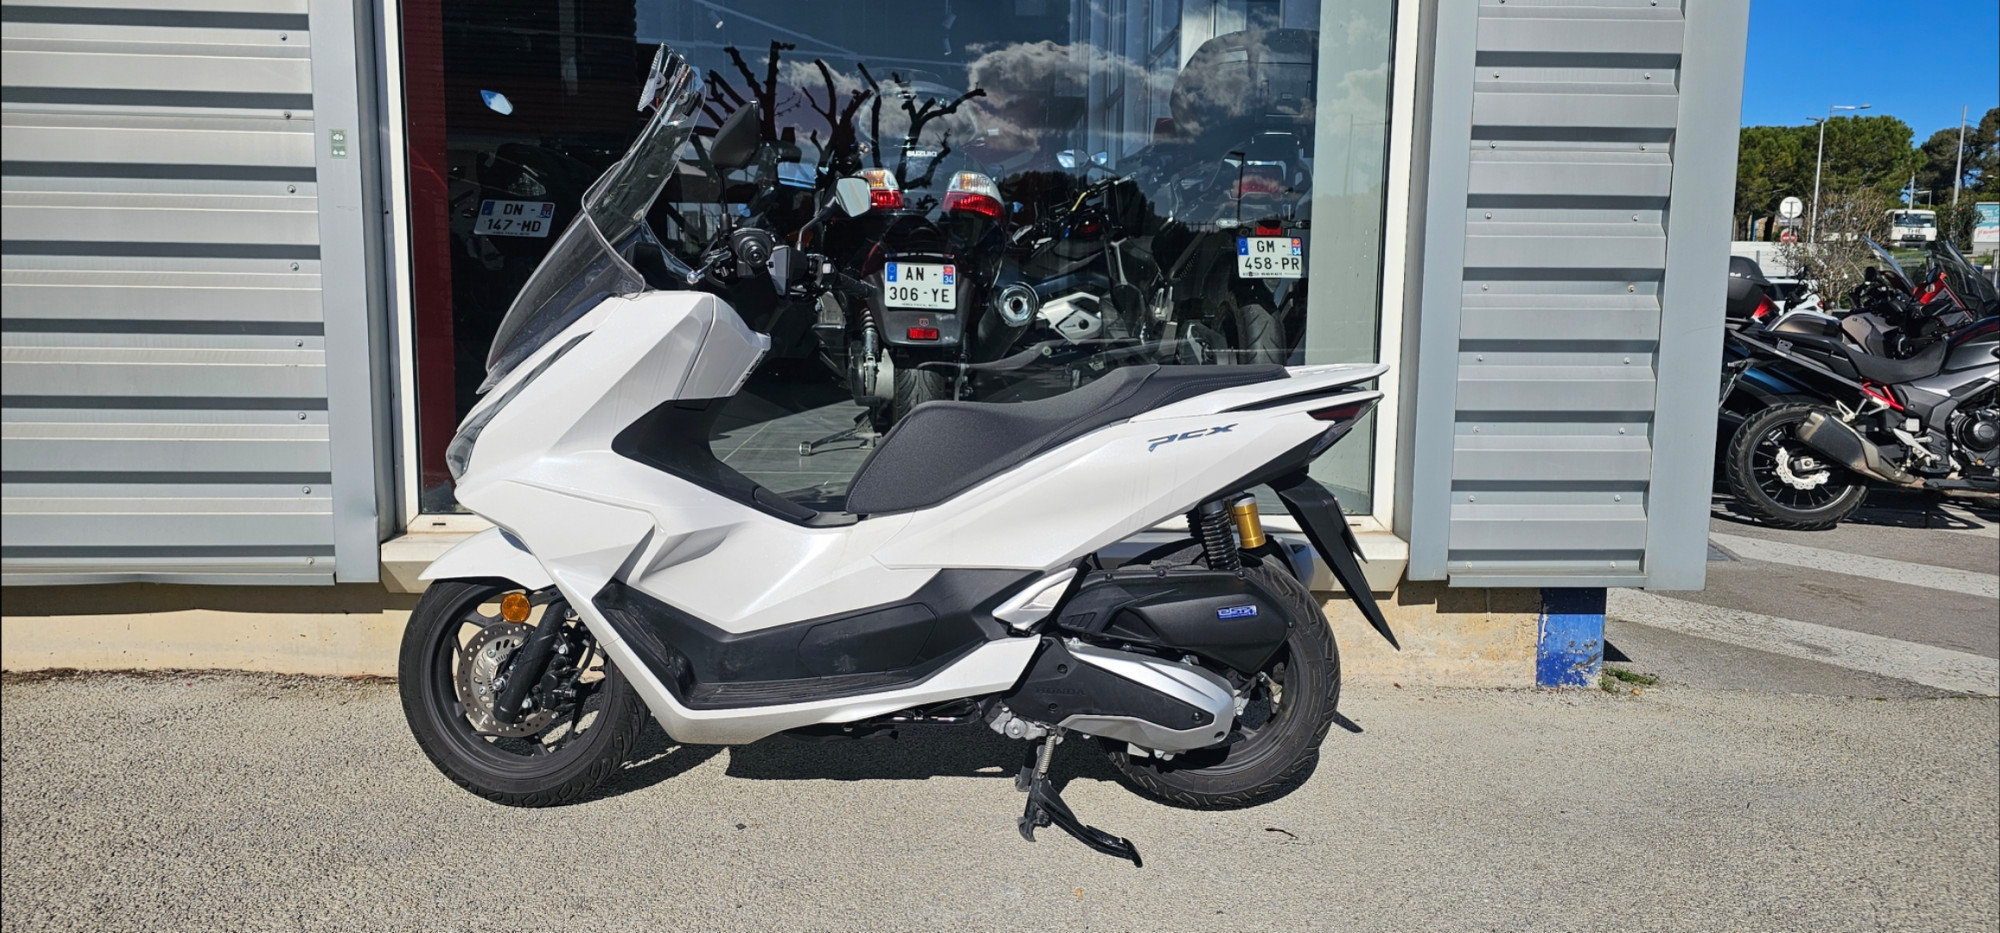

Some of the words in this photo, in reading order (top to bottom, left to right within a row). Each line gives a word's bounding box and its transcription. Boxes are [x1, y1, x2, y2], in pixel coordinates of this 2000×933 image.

[503, 203, 524, 216] DN
[1256, 240, 1275, 253] GM
[905, 266, 925, 281] AN
[943, 275, 954, 284] 34
[1147, 423, 1239, 452] PCX
[1033, 686, 1086, 695] HONDA
